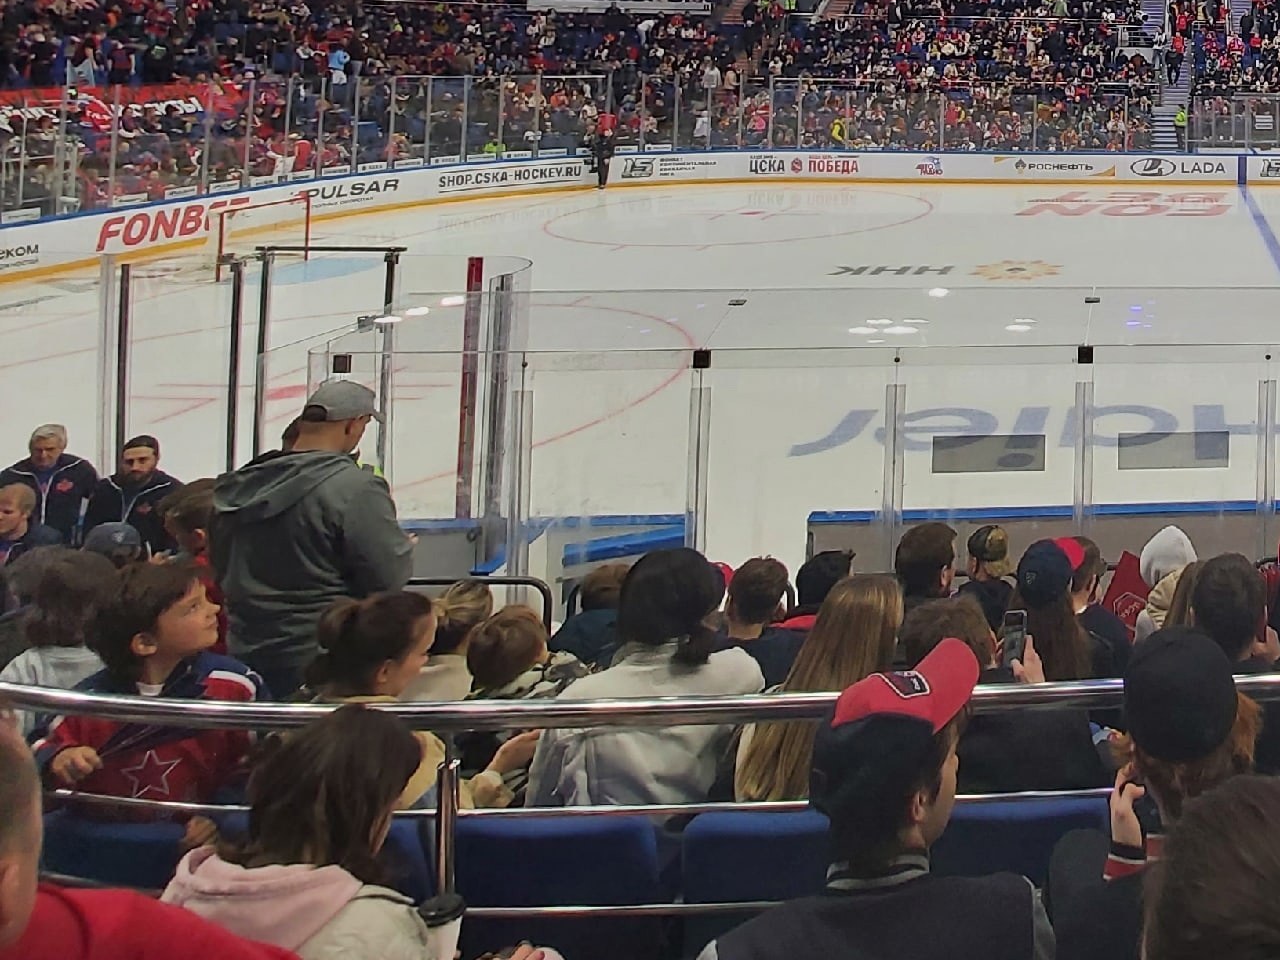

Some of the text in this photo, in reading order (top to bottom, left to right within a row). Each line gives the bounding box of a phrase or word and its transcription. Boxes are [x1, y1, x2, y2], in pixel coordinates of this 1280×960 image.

[749, 160, 859, 176] ЦСКА ПОБЕДА
[1028, 163, 1094, 171] РОСНЕФТЬ
[1181, 162, 1226, 174] LADA
[438, 165, 582, 189] SHOP.CSKA-HOCKEY.RU
[307, 179, 400, 200] PULSAR
